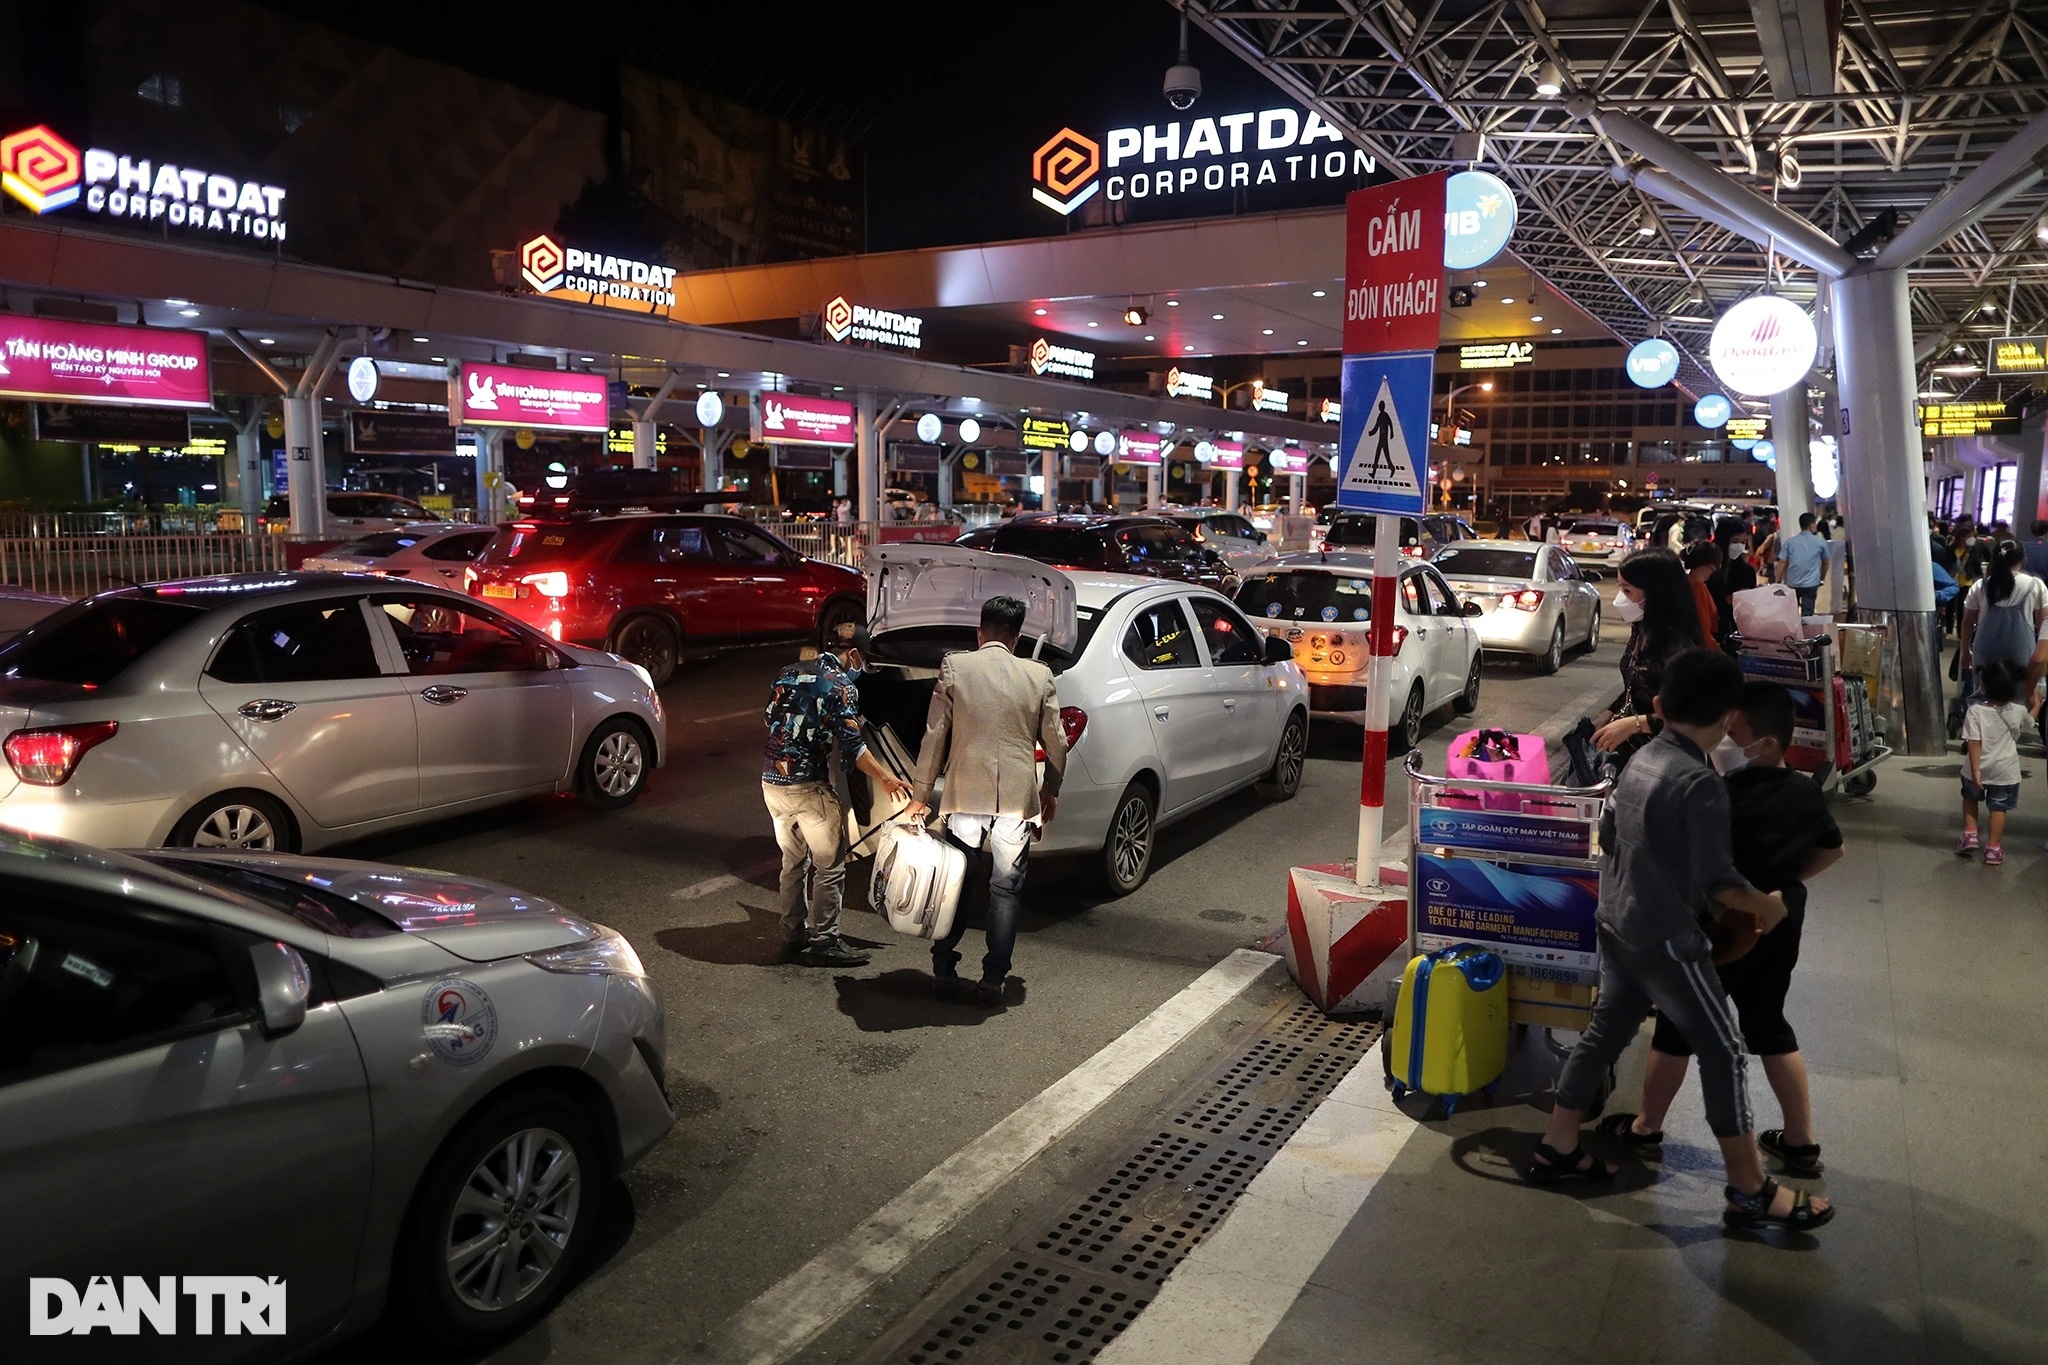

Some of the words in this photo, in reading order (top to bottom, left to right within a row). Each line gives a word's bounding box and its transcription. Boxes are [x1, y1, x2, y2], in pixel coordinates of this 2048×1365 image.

[1107, 107, 1344, 168] PHATDA
[84, 147, 286, 218] PHATDAT
[1107, 149, 1376, 201] CORPORATION
[87, 184, 286, 240] CORPORATION
[1368, 197, 1421, 257] CẤM
[565, 248, 676, 289] PHATDAT
[565, 274, 676, 307] CORPORATION
[1348, 279, 1379, 321] ĐÓN
[1383, 273, 1438, 317] KHÁCH
[852, 305, 922, 335] PHATDAT
[851, 326, 921, 349] CORPORATION
[6, 339, 40, 358] TÂN
[43, 343, 103, 362] HOÀNG
[107, 351, 144, 366] MINH
[147, 353, 198, 370] GROUP
[74, 363, 93, 374] TẠO
[1631, 358, 1661, 372] VIB
[1461, 823, 1475, 831] TẬP
[1478, 822, 1501, 833] ĐOÀN
[1503, 826, 1518, 836] DỆT
[1520, 828, 1538, 837] MAY
[1539, 829, 1557, 839] VIỆT
[1559, 832, 1579, 840] NAM
[1428, 905, 1445, 916] ONE
[1447, 907, 1457, 918] OF
[1460, 909, 1476, 920] THE
[1479, 911, 1515, 924] LEADING
[1428, 915, 1457, 928] TEXTILE
[1459, 919, 1474, 930] AND
[1476, 921, 1512, 934] GARMENT
[1513, 926, 1580, 942] MANUFACTURERS
[1558, 940, 1580, 948] WORLD
[1530, 967, 1578, 983] 1869898
